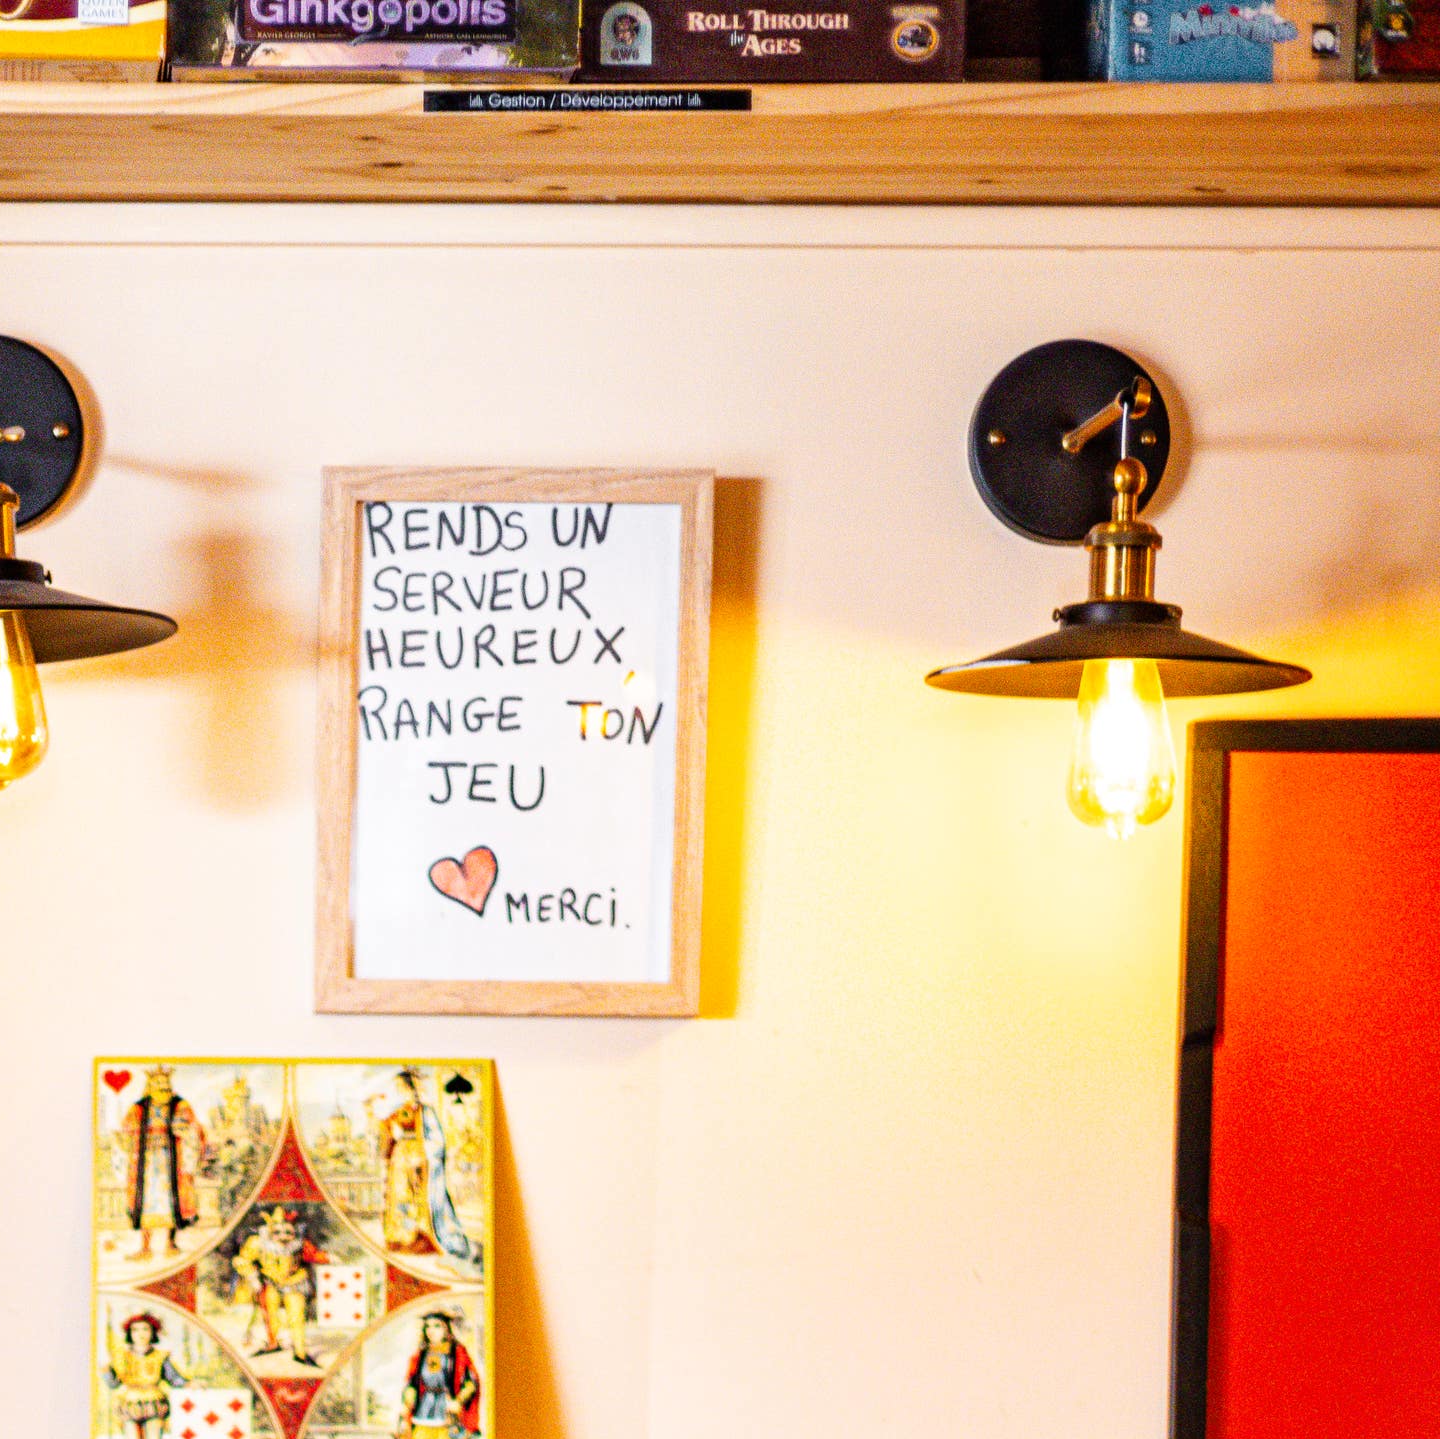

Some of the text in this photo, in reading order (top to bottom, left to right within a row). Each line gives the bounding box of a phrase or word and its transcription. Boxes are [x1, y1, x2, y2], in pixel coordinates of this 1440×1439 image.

[250, 0, 507, 32] Ginkgopolis
[488, 92, 546, 108] Gestion
[561, 91, 682, 109] Développement
[364, 500, 613, 557] RENDS UN
[373, 566, 591, 619] SERVEUR
[357, 685, 664, 745] RANGE TON
[427, 761, 546, 812] JEU
